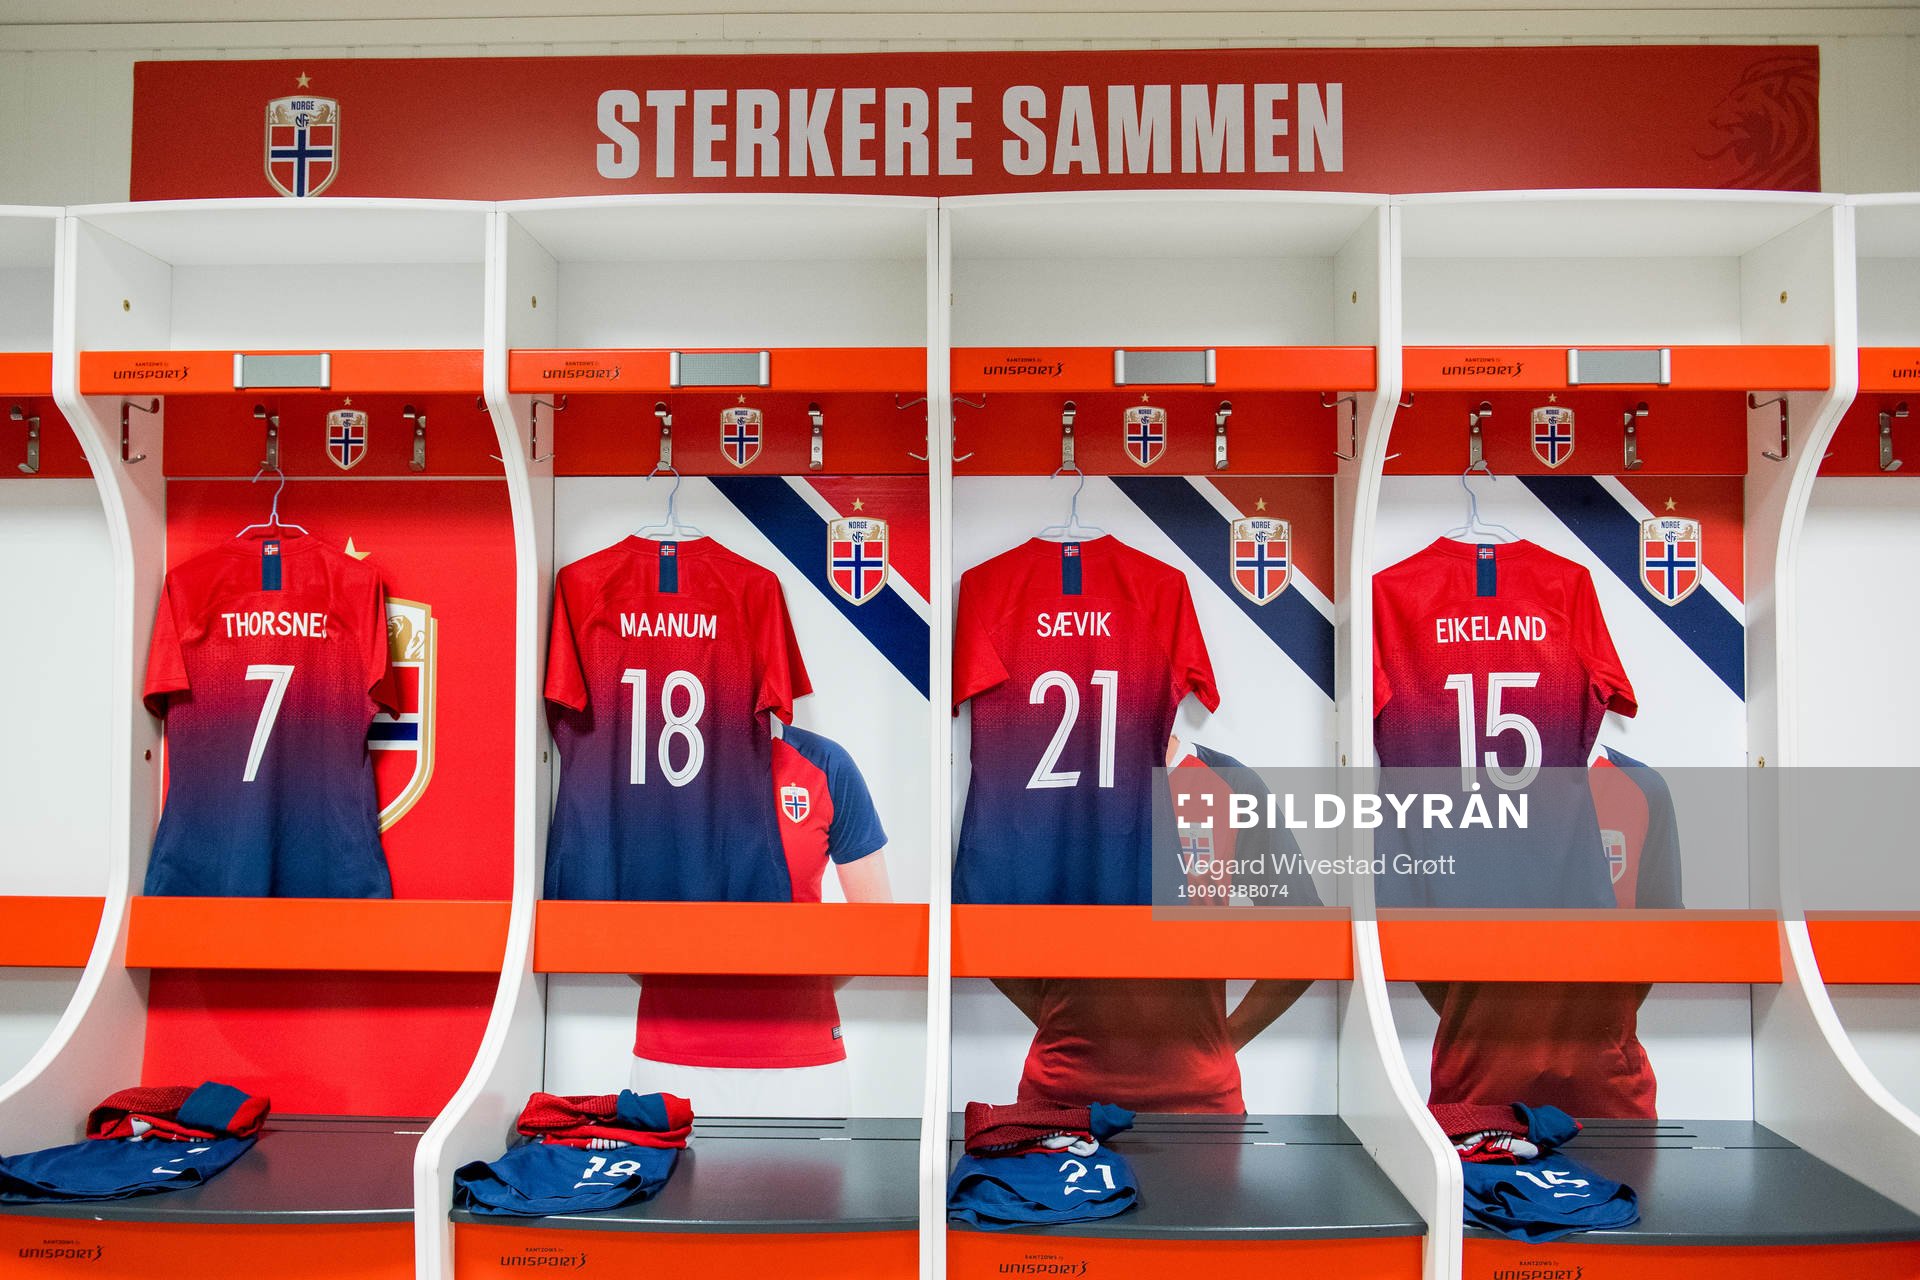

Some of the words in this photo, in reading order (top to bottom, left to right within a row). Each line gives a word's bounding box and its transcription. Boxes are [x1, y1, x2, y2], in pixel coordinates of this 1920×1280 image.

[291, 101, 314, 110] NORGE
[596, 86, 973, 179] STERKERE
[1002, 82, 1343, 175] SAMMEN
[113, 369, 180, 380] UNISPORT
[543, 369, 611, 379] UNISPORT
[983, 365, 1056, 375] UNISPORT
[1442, 365, 1514, 376] UNISPORT
[848, 521, 867, 529] NORGE
[1251, 521, 1271, 529] NORGE
[1661, 521, 1680, 529] NORGE
[620, 612, 717, 639] MAANUM
[1036, 611, 1112, 638] SÆVIK
[1436, 615, 1547, 644] EIKELAND
[242, 664, 295, 782] 7
[620, 668, 706, 788] 18
[1025, 669, 1118, 789] 21
[1443, 672, 1542, 792] 15
[19, 1248, 95, 1259] UNISPORT
[500, 1256, 577, 1267] UNISPORT
[999, 1263, 1078, 1274] UNISPORT
[1493, 1270, 1574, 1280] UNISPORT
